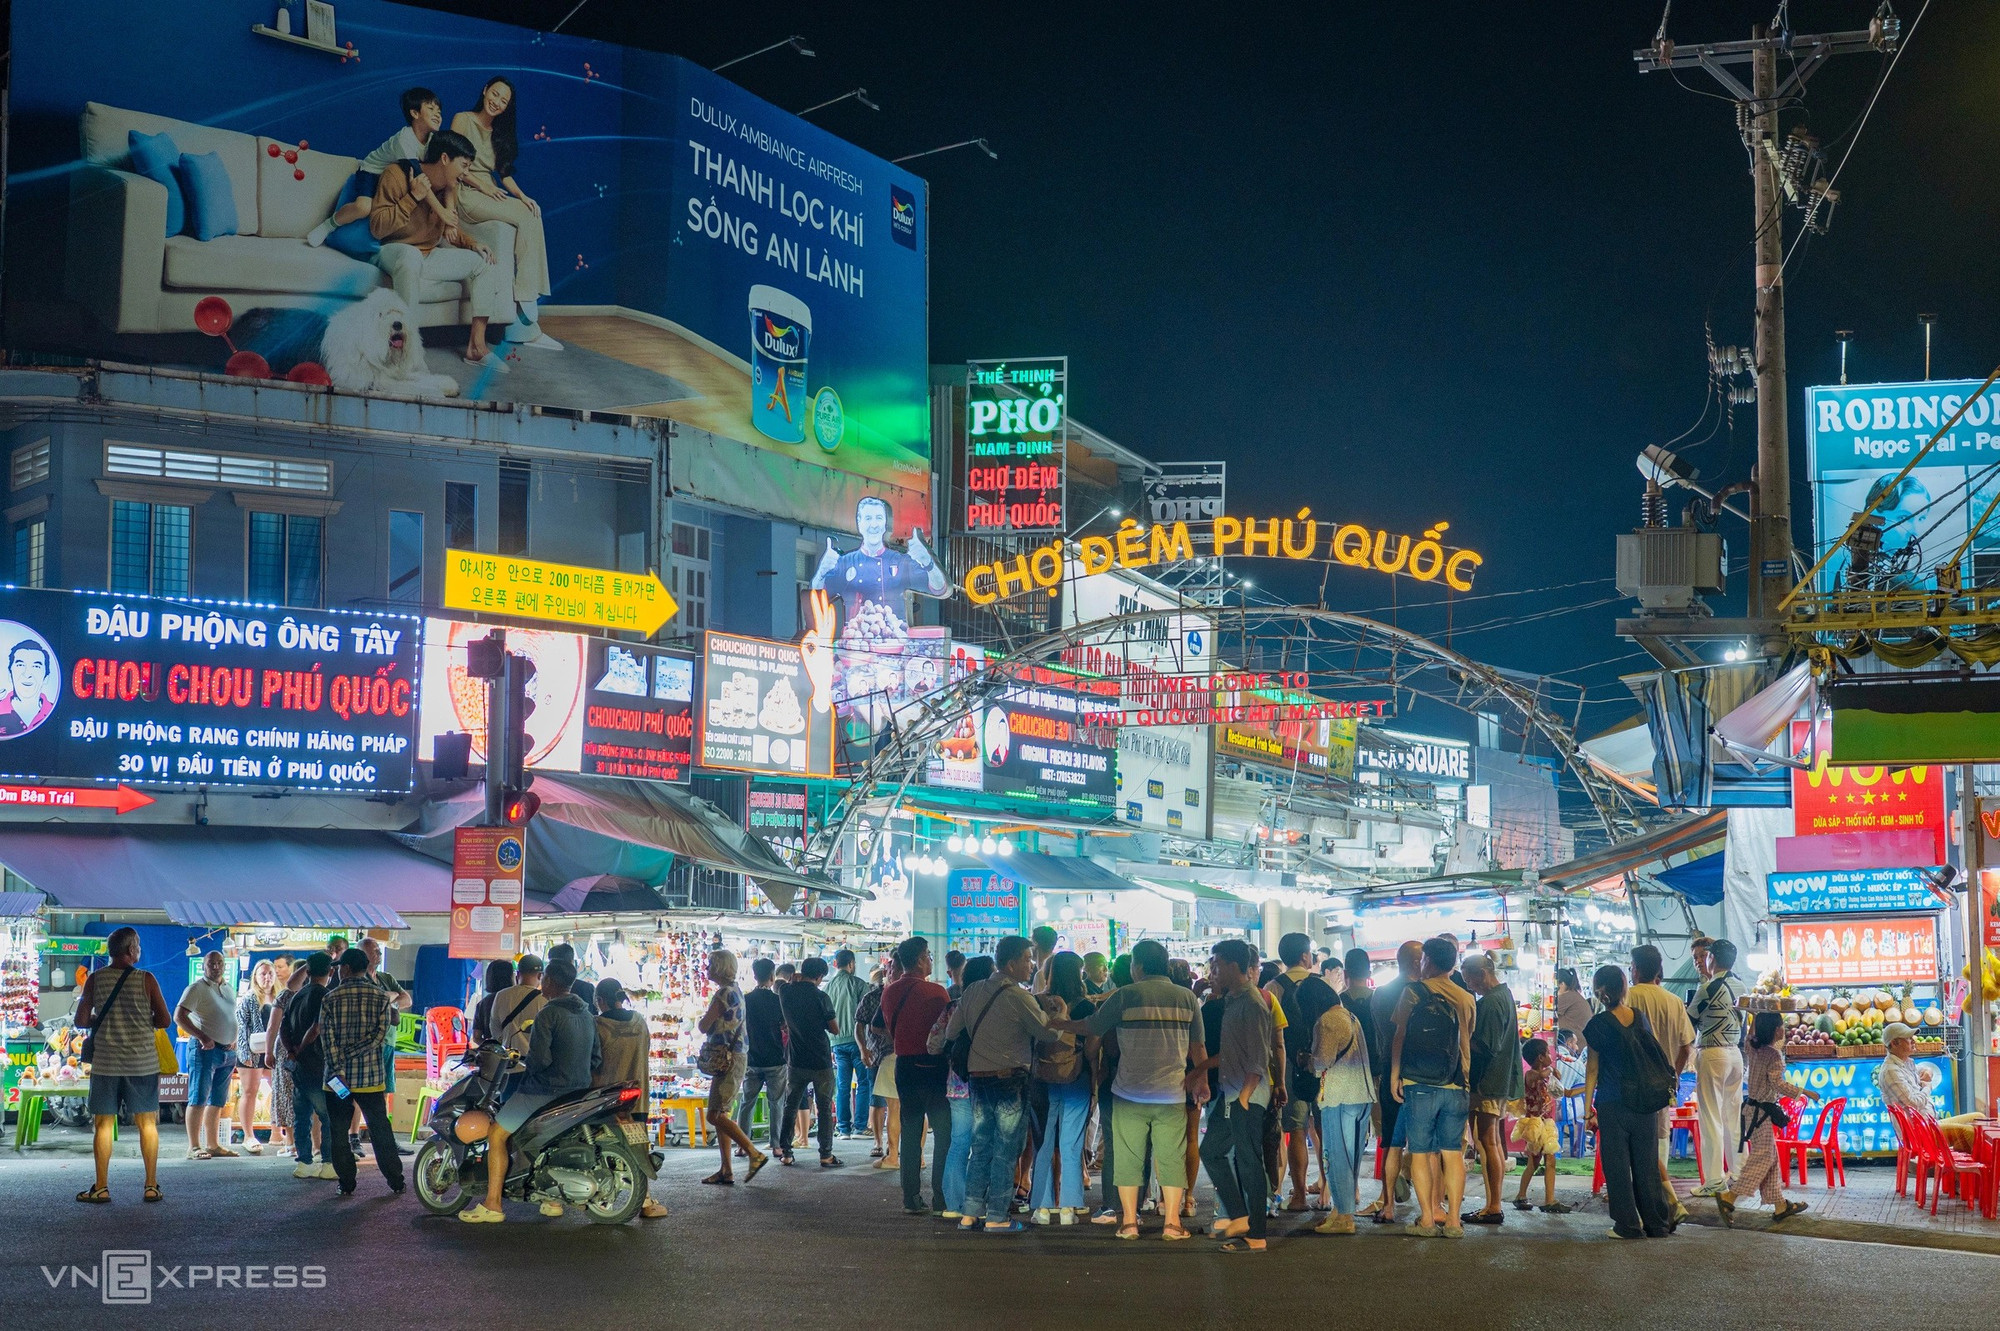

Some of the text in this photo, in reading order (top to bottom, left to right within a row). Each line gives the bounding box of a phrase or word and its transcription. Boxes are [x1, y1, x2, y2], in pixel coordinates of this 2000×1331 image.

[691, 97, 863, 196] DULUX AMBIANCE AIRFRESH
[689, 139, 864, 248] THANH LỌC KHÍ
[893, 207, 913, 227] Dulux
[687, 194, 864, 298] SỐNG AN LÀNH
[765, 332, 797, 358] Dulux
[1011, 368, 1055, 387] THỊNH
[970, 382, 1063, 435] PHỞ
[1817, 393, 2000, 433] ROBINSO
[975, 441, 1053, 458] NAM ĐỊNH
[1854, 436, 1910, 458] Ngọc
[969, 461, 1058, 496] CHỢ ĐÊM
[968, 489, 1061, 529] PHÚ QUỐC
[965, 506, 1483, 605] CHỢ ĐÊM PHÚ QUỐC
[460, 558, 656, 601] 야시장 안으로 200 미터쯤 들어가면
[471, 586, 507, 607] 오른쪽
[515, 591, 539, 612] 편에
[543, 594, 586, 618] 주인님이
[87, 603, 401, 655] ĐẬU PHỘNG ÔNG TÂY
[710, 638, 800, 663] CHOUCHOU PHU QUOC
[711, 653, 727, 666] THE
[727, 655, 758, 671] ORIGINAL
[72, 658, 410, 720] CHOU CHOU PHÚ QUỐC
[1158, 671, 1309, 693] WELCOME TO
[588, 705, 692, 740] CHOUCHOU PHÚ QUỐC
[1009, 712, 1056, 739] CHOUCHOU
[1084, 709, 1127, 728] PHU
[1136, 708, 1198, 727] QUOC
[1208, 704, 1278, 723] NIGHT
[1289, 699, 1387, 719] MARKET
[70, 718, 408, 754] ĐẬU PHỘNG RANG CHÍNH HÃNG PHÁP
[1227, 728, 1256, 750] Restaurant
[118, 751, 376, 784] 30 VỊ ĐẦU TIÊN Ở PHÚ QUỐC
[1406, 743, 1469, 779] SQUARE
[21, 790, 46, 803] Bên
[48, 790, 75, 804] Trái
[787, 814, 795, 827] 30
[1880, 815, 1894, 825] KEM
[1899, 814, 1914, 825] SINH
[962, 877, 982, 891] IN
[1773, 875, 1828, 896] WOW
[1828, 886, 1848, 894] SINH
[951, 893, 973, 907] QUÀ
[62, 943, 79, 951] 20K
[1785, 1065, 1856, 1089] WOW
[171, 1088, 184, 1096] CAY
